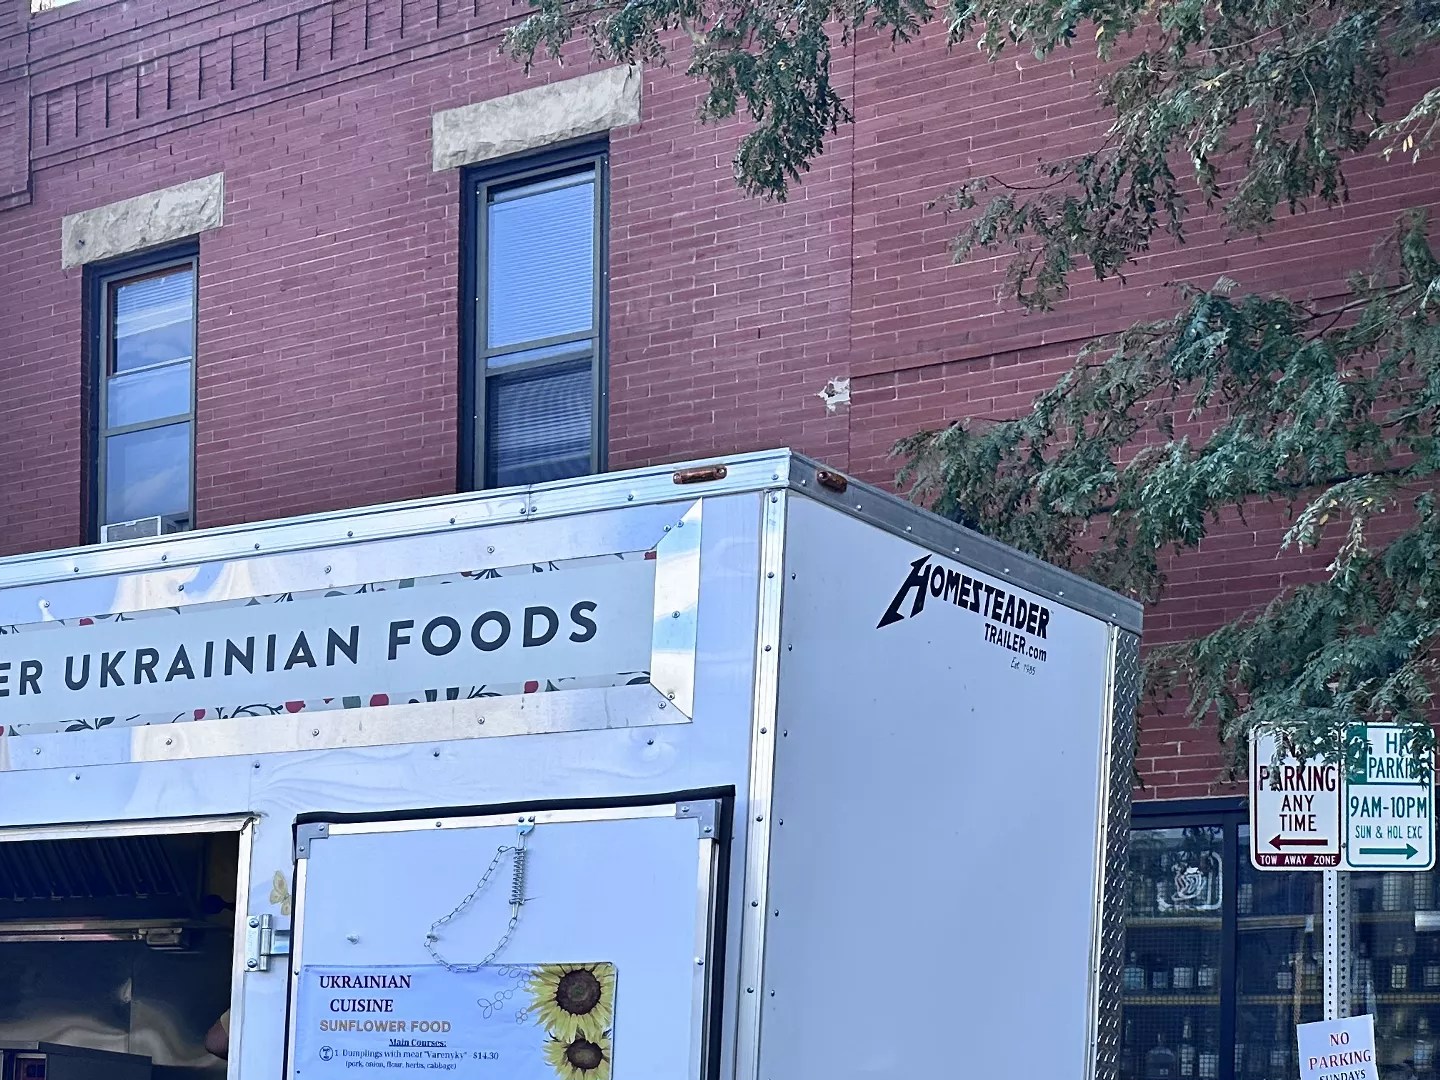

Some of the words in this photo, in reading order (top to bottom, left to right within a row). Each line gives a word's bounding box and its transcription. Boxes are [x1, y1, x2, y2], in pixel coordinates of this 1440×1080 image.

[876, 553, 1051, 640] HOMESTEADER
[64, 624, 360, 692] UKRAINIAN
[387, 600, 598, 661] FOODS
[984, 622, 1047, 662] TRAILER.com
[1369, 757, 1423, 779] PARKI
[1281, 794, 1315, 812] ANY
[1350, 796, 1427, 818] 9AM-10PM
[1279, 814, 1317, 832] TIME
[1355, 825, 1372, 839] SUN
[1375, 825, 1383, 839] &
[1387, 825, 1403, 839] HOL
[1407, 825, 1423, 839] EXC
[1260, 855, 1278, 865] TOW
[1284, 855, 1307, 865] AWAY
[1313, 855, 1336, 865] ZONE
[319, 975, 412, 989] UKRAINIAN
[330, 998, 394, 1013] CUISINE
[319, 1019, 406, 1032] SUNFLOWER
[410, 1020, 451, 1033] FOOD
[389, 1038, 410, 1047] Main
[1329, 1031, 1350, 1047] NO
[341, 1048, 383, 1059] Dumplings
[383, 1049, 402, 1057] with
[403, 1049, 423, 1057] meat
[472, 1050, 499, 1059] $14.30
[1309, 1049, 1372, 1071] PARKING
